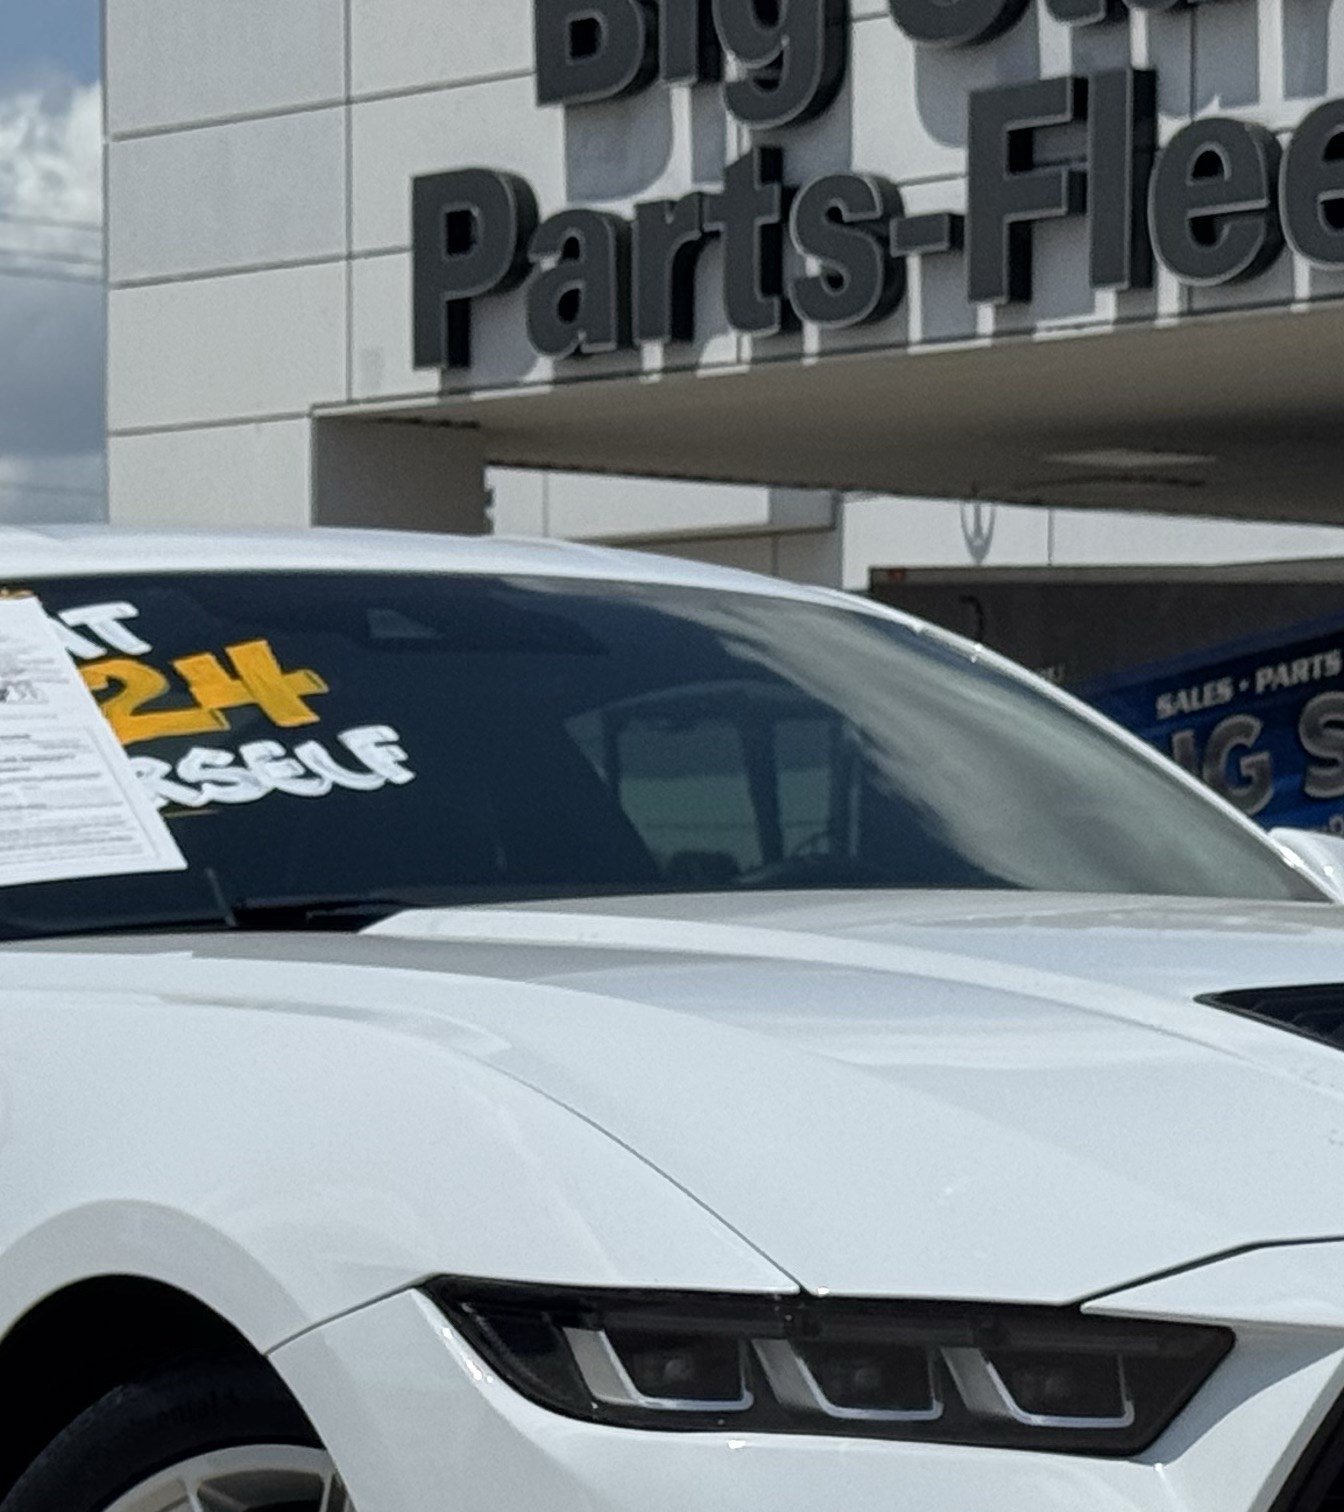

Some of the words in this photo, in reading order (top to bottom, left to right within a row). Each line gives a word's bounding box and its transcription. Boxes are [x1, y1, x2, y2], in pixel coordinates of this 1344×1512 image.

[1155, 678, 1234, 720] SALES
[1255, 648, 1344, 694] PARTS
[1171, 714, 1274, 817] IG
